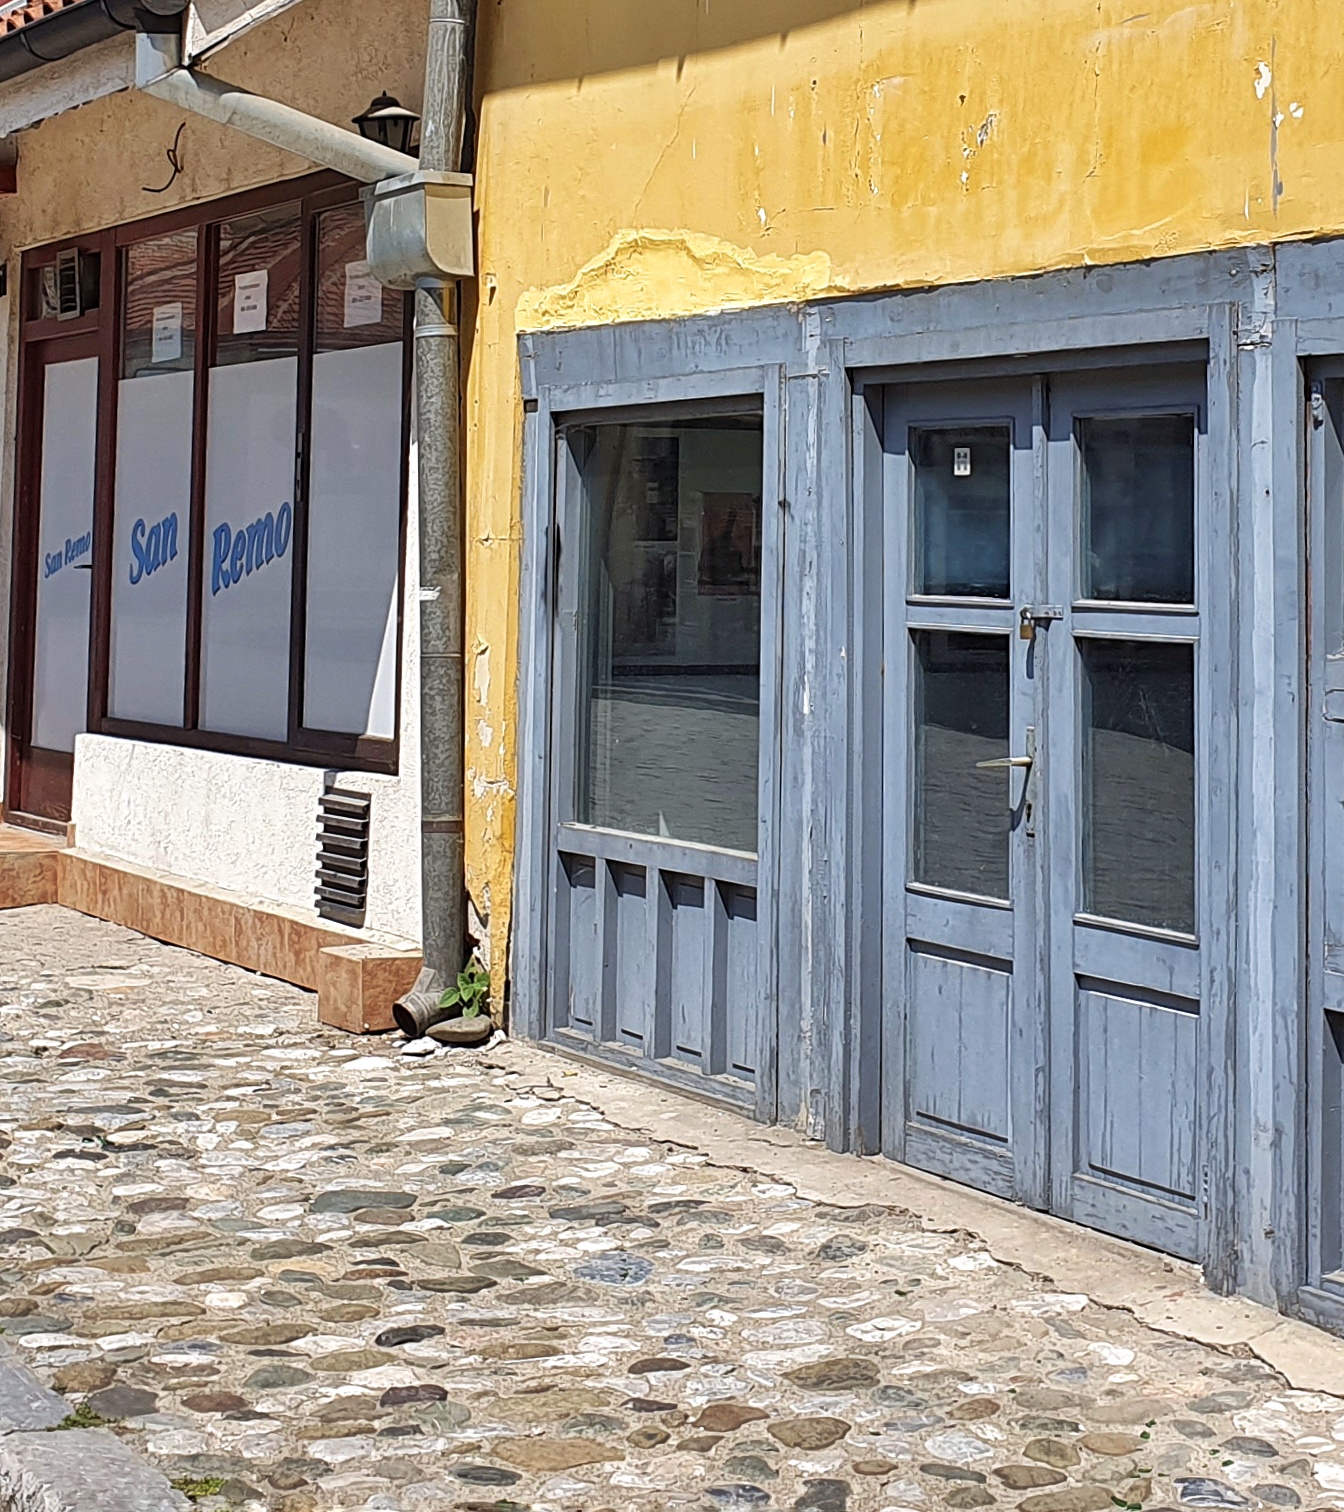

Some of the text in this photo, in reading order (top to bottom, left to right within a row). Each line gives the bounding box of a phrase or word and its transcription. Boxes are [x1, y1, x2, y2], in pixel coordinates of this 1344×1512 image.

[44, 531, 91, 579] San Remo
[129, 501, 292, 597] San Remo
